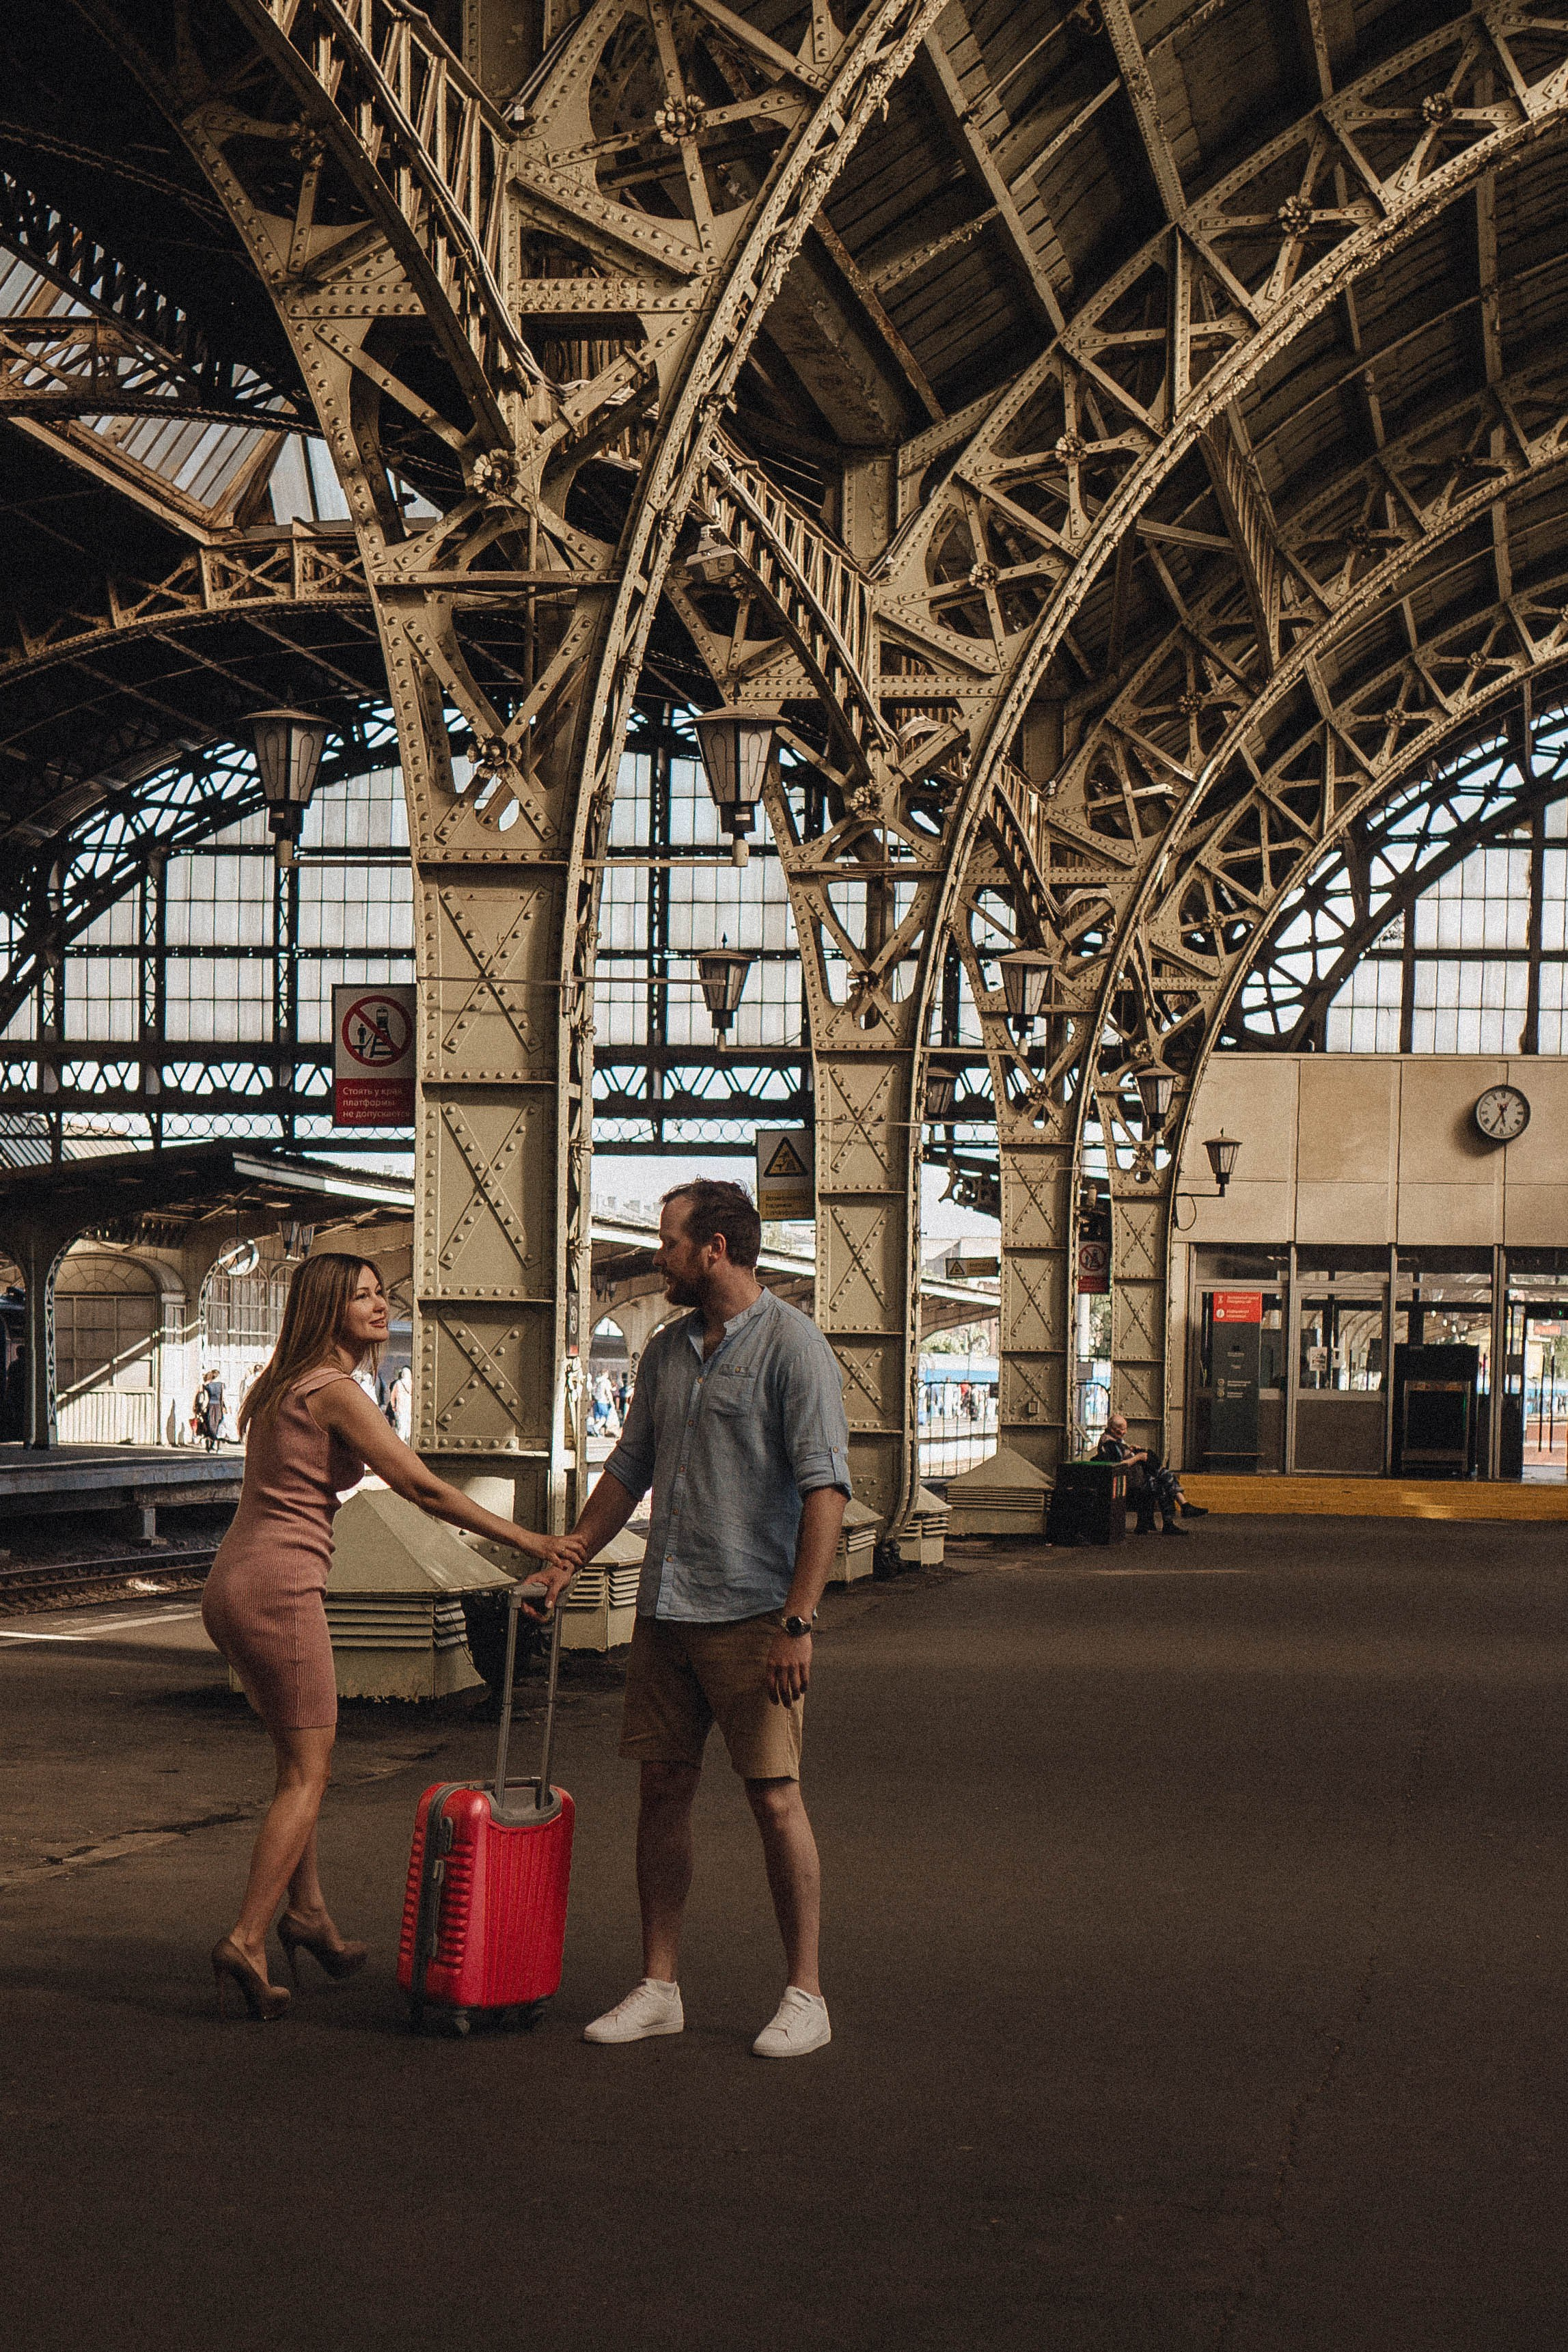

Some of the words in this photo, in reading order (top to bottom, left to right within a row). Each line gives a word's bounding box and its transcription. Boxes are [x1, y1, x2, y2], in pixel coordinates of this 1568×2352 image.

[342, 1086, 373, 1095] Стоять
[374, 1089, 380, 1097] у
[381, 1089, 403, 1097] края
[342, 1099, 396, 1108] платформы
[355, 1111, 411, 1119] допускается
